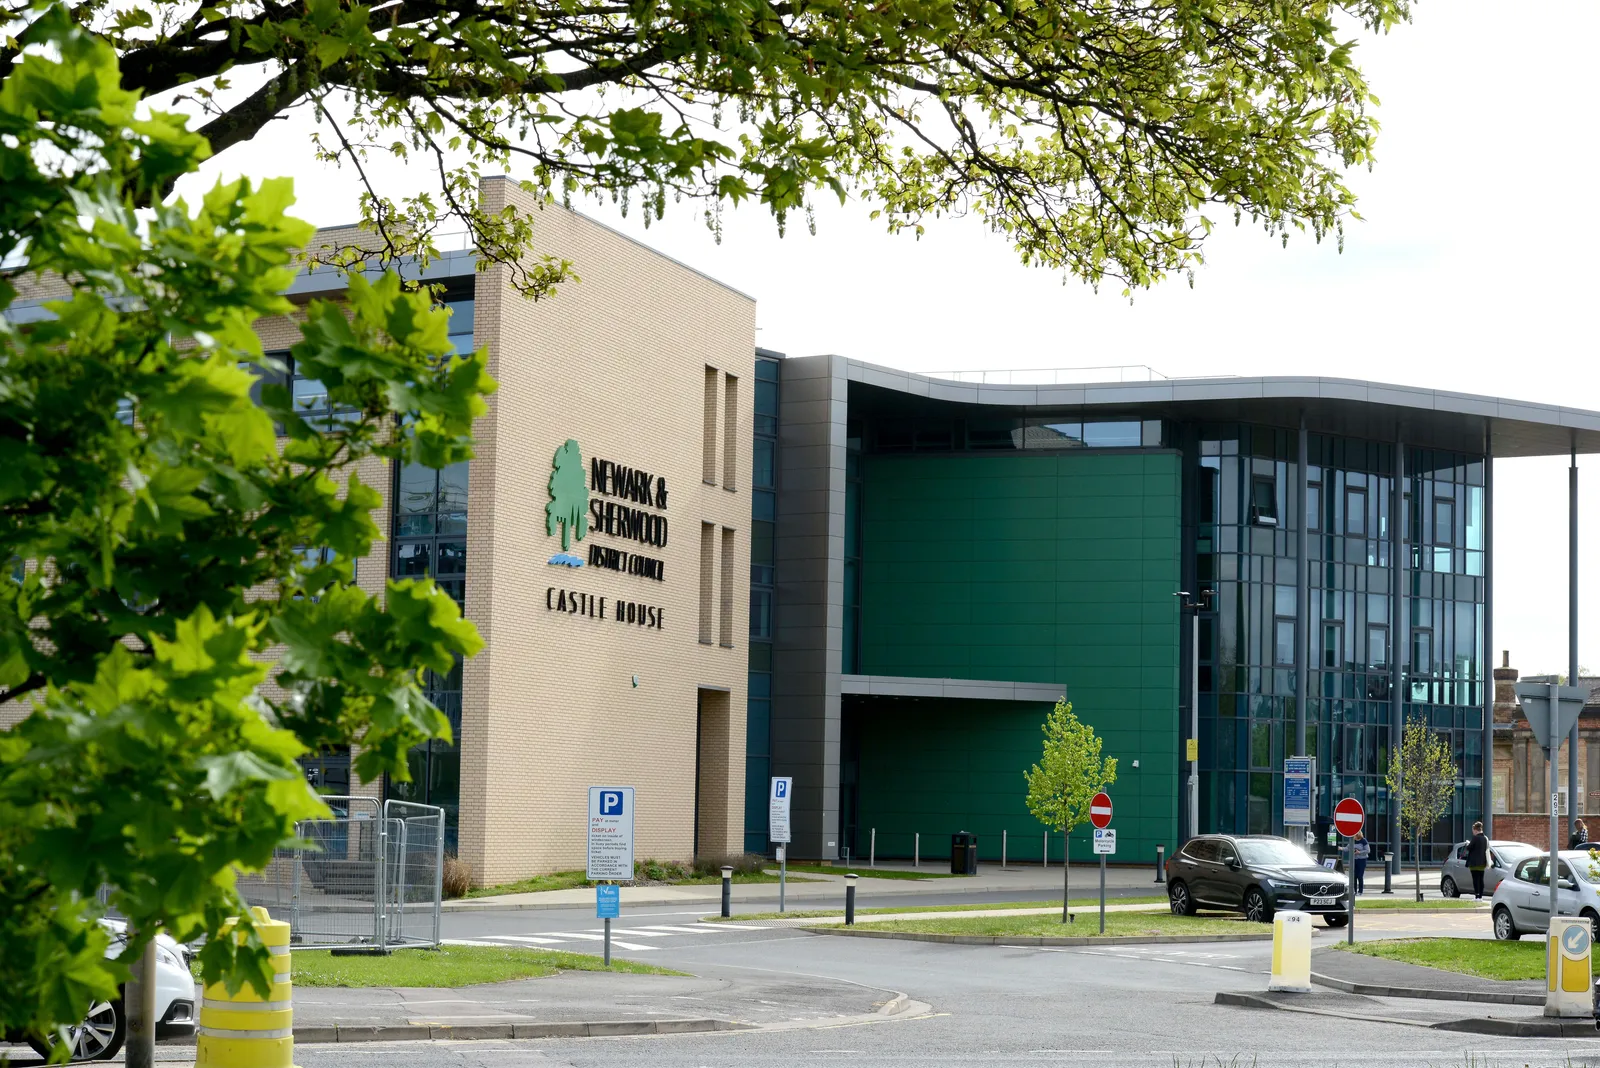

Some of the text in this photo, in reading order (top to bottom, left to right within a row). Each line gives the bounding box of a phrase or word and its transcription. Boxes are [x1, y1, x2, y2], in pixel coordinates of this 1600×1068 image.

[591, 457, 668, 510] NEWARK &
[589, 498, 668, 548] SHERWOOD
[588, 544, 665, 582] DISTRICT COUNCIL
[547, 587, 665, 630] CASTLE HOUSE
[604, 793, 618, 813] P
[778, 782, 785, 796] P
